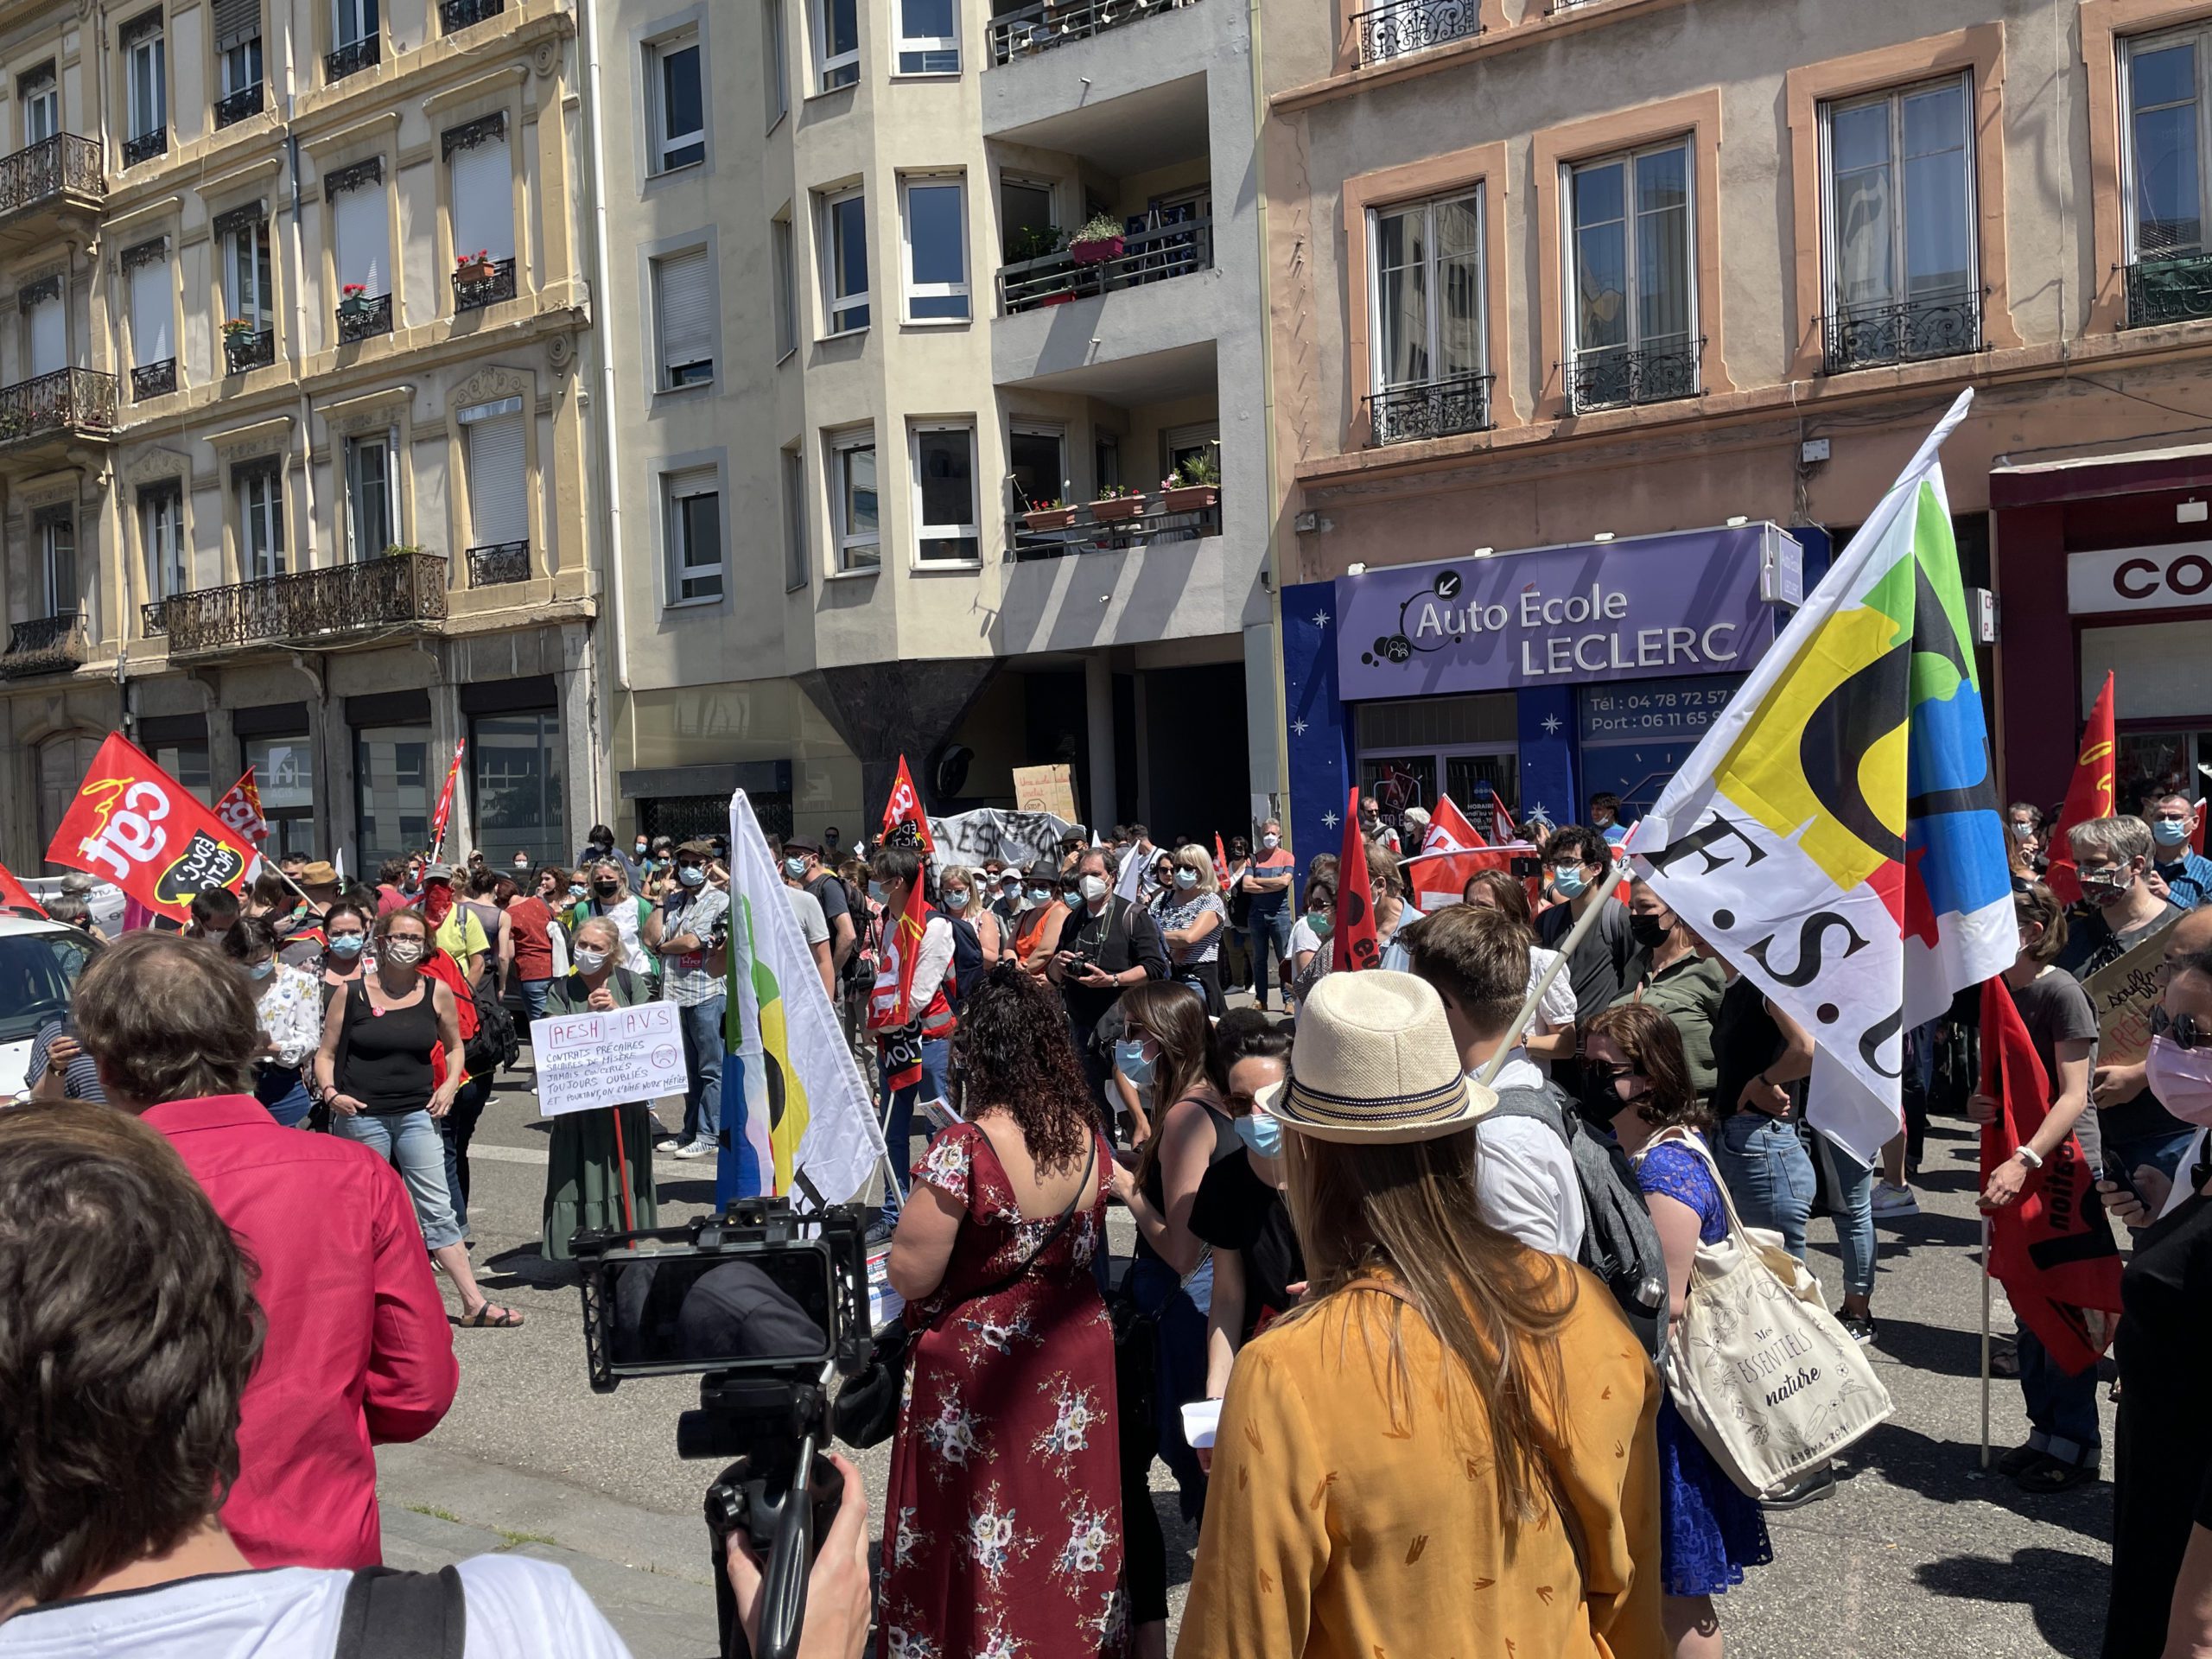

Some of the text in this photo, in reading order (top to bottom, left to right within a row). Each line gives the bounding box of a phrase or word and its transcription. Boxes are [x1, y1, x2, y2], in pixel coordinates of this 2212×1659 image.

[1416, 582, 1628, 639] Auto École
[1522, 622, 1738, 677] LECLERC
[1591, 697, 1614, 711] Tél
[1628, 696, 1651, 709] 04
[1656, 694, 1676, 707] 78
[1681, 692, 1702, 706] 72
[1707, 690, 1727, 704] 57
[1592, 716, 1628, 730] Port
[1642, 714, 1663, 728] 06
[1668, 713, 1681, 726] 11
[1687, 712, 1707, 725] 65
[554, 1020, 598, 1045] AESH
[547, 1040, 645, 1063] CONTRATS PRÉCAIRES
[587, 1058, 598, 1067] DE
[547, 1067, 649, 1095] TOUJOURS OUBLIÉS
[547, 1096, 559, 1106] ET
[1754, 1327, 1773, 1343] Mes
[1737, 1327, 1813, 1383] ESSENTIELS
[1765, 1367, 1821, 1407] nature
